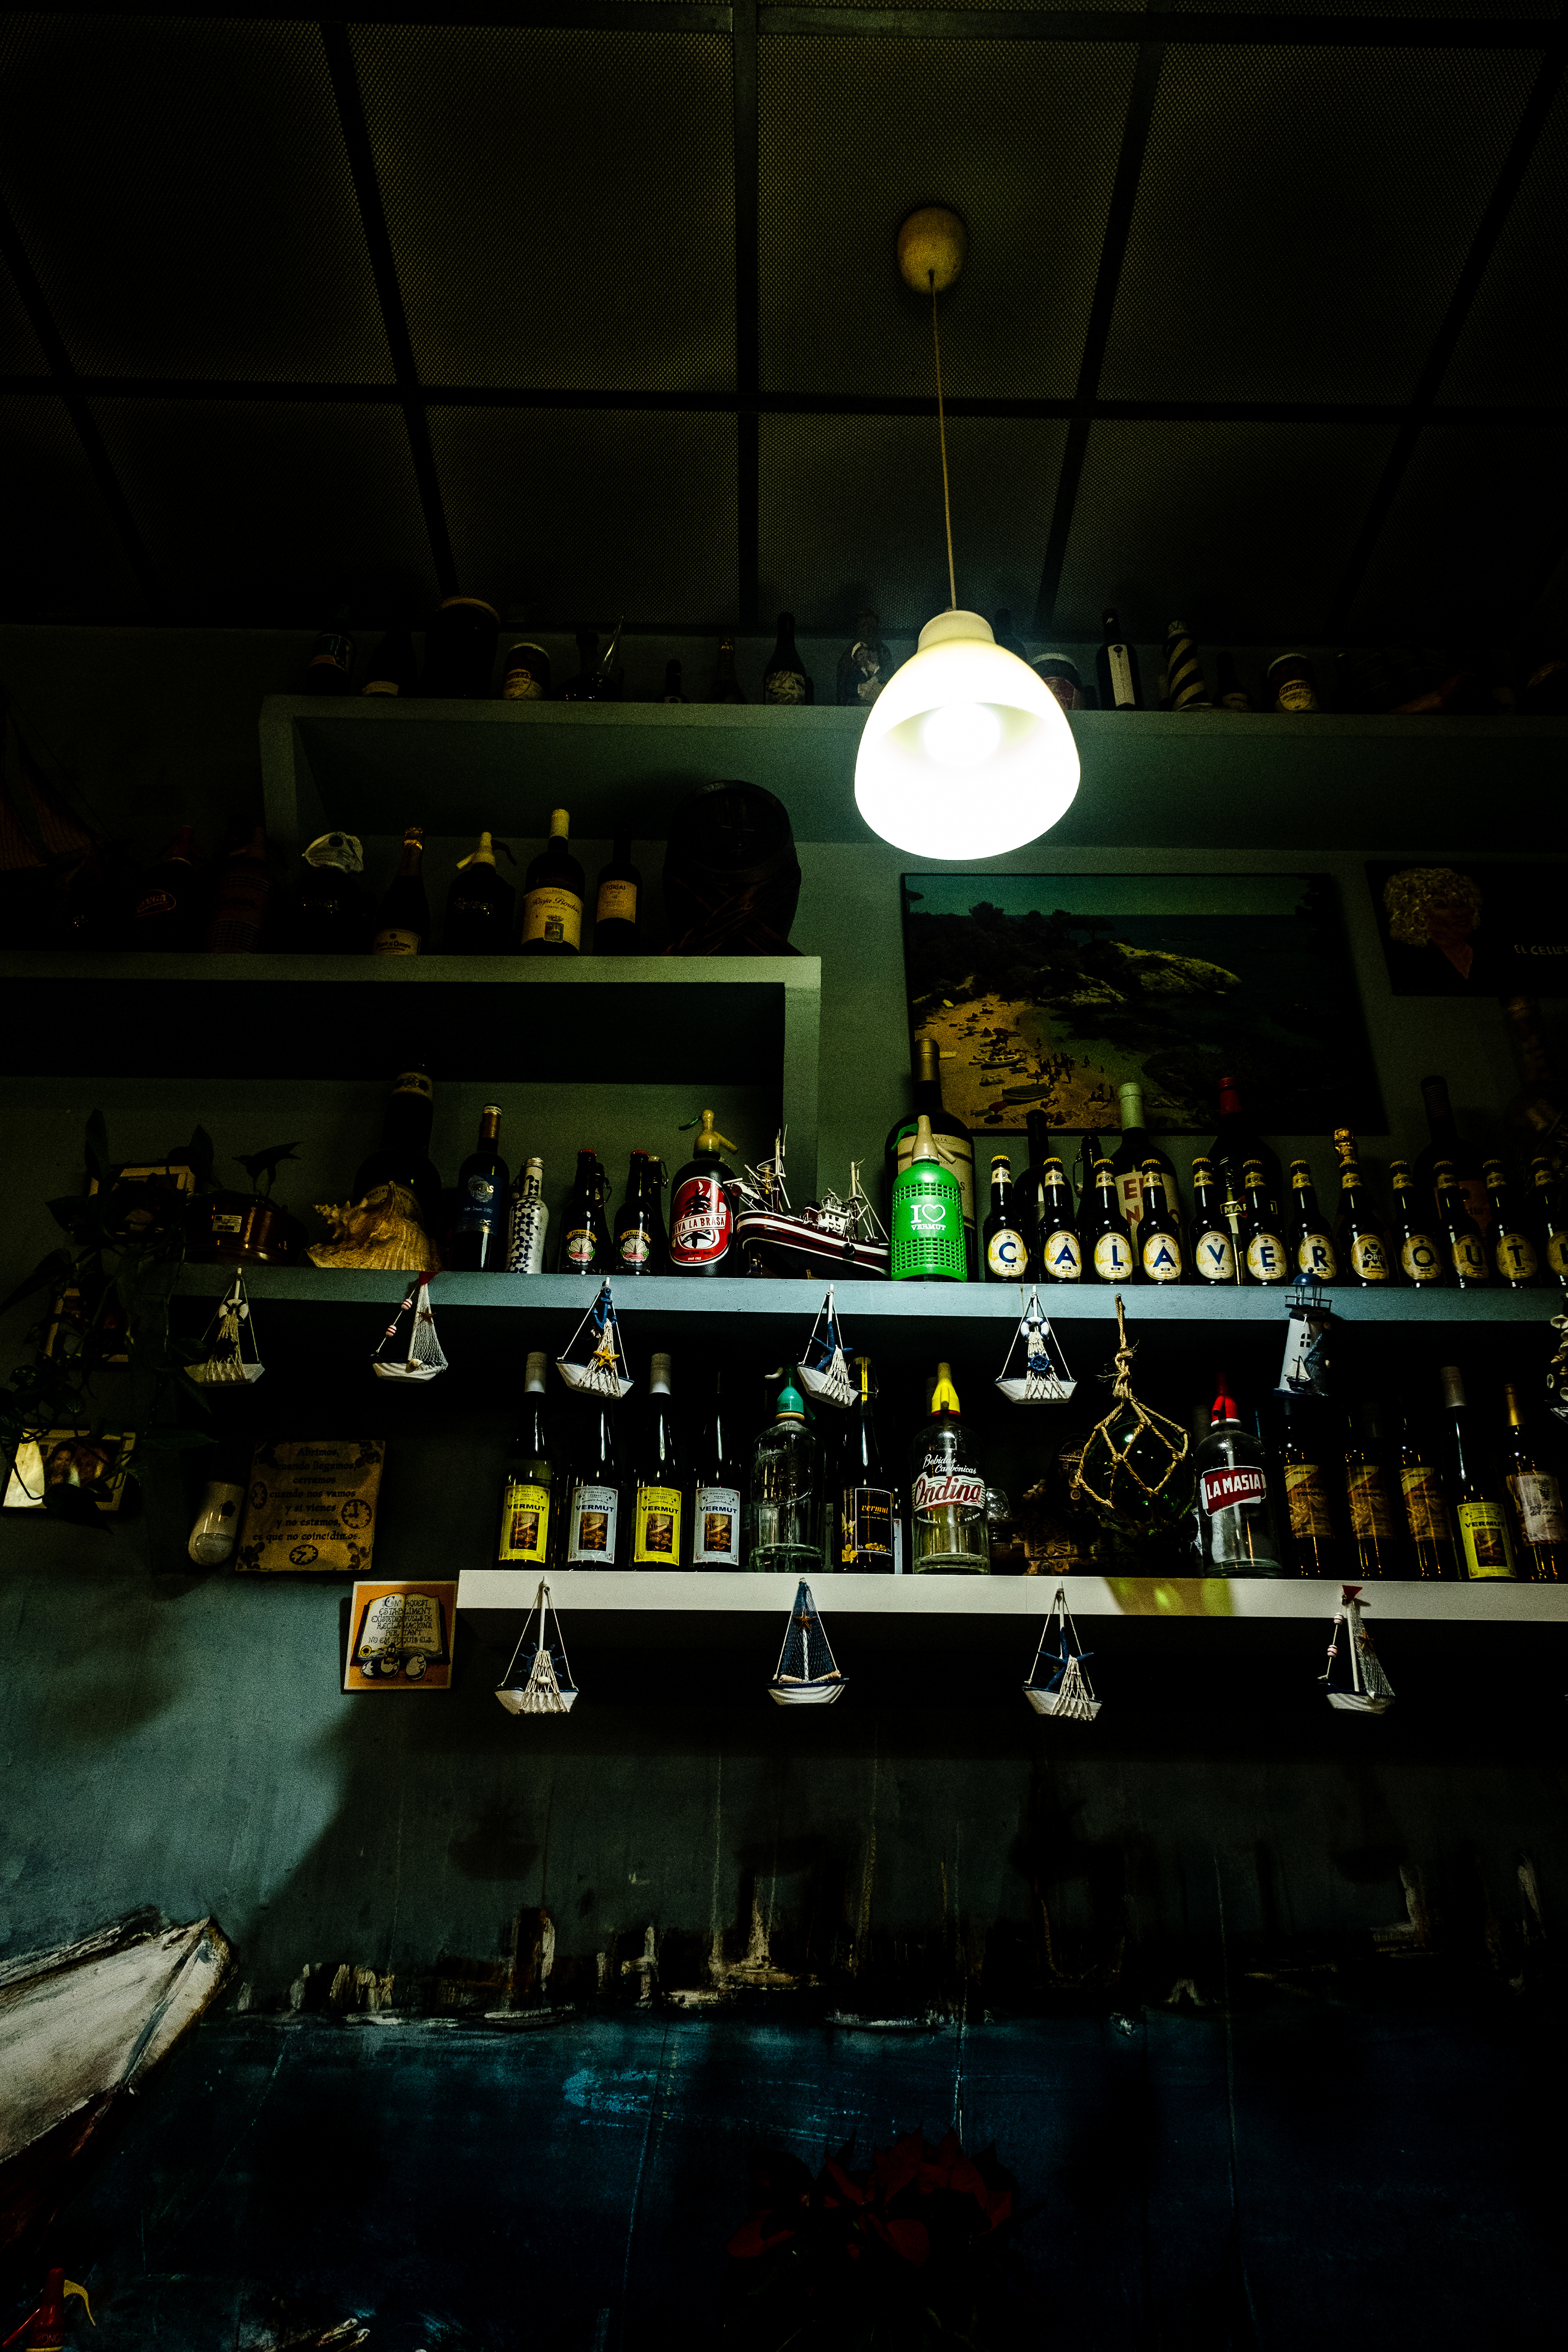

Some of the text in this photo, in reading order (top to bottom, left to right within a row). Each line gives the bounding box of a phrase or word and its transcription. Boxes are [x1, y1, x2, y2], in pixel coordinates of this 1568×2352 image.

[1514, 944, 1528, 954] EL
[910, 1204, 922, 1224] I
[673, 1216, 724, 1236] VIVA LA BRASA
[297, 1446, 340, 1457] Abrimos,
[312, 1461, 356, 1472] llegamos,
[922, 1454, 957, 1469] Bebidas
[935, 1464, 977, 1474] Carbónicas
[914, 1476, 981, 1506] Ondina
[1207, 1474, 1261, 1500] LA MASIA
[269, 1488, 303, 1498] cuando
[285, 1505, 292, 1515] y
[641, 1506, 679, 1514] VERMUT
[699, 1506, 737, 1514] VERMUT
[861, 1505, 889, 1514] vermut
[276, 1520, 282, 1529] y
[300, 1518, 341, 1527] estamos,
[266, 1534, 283, 1544] que
